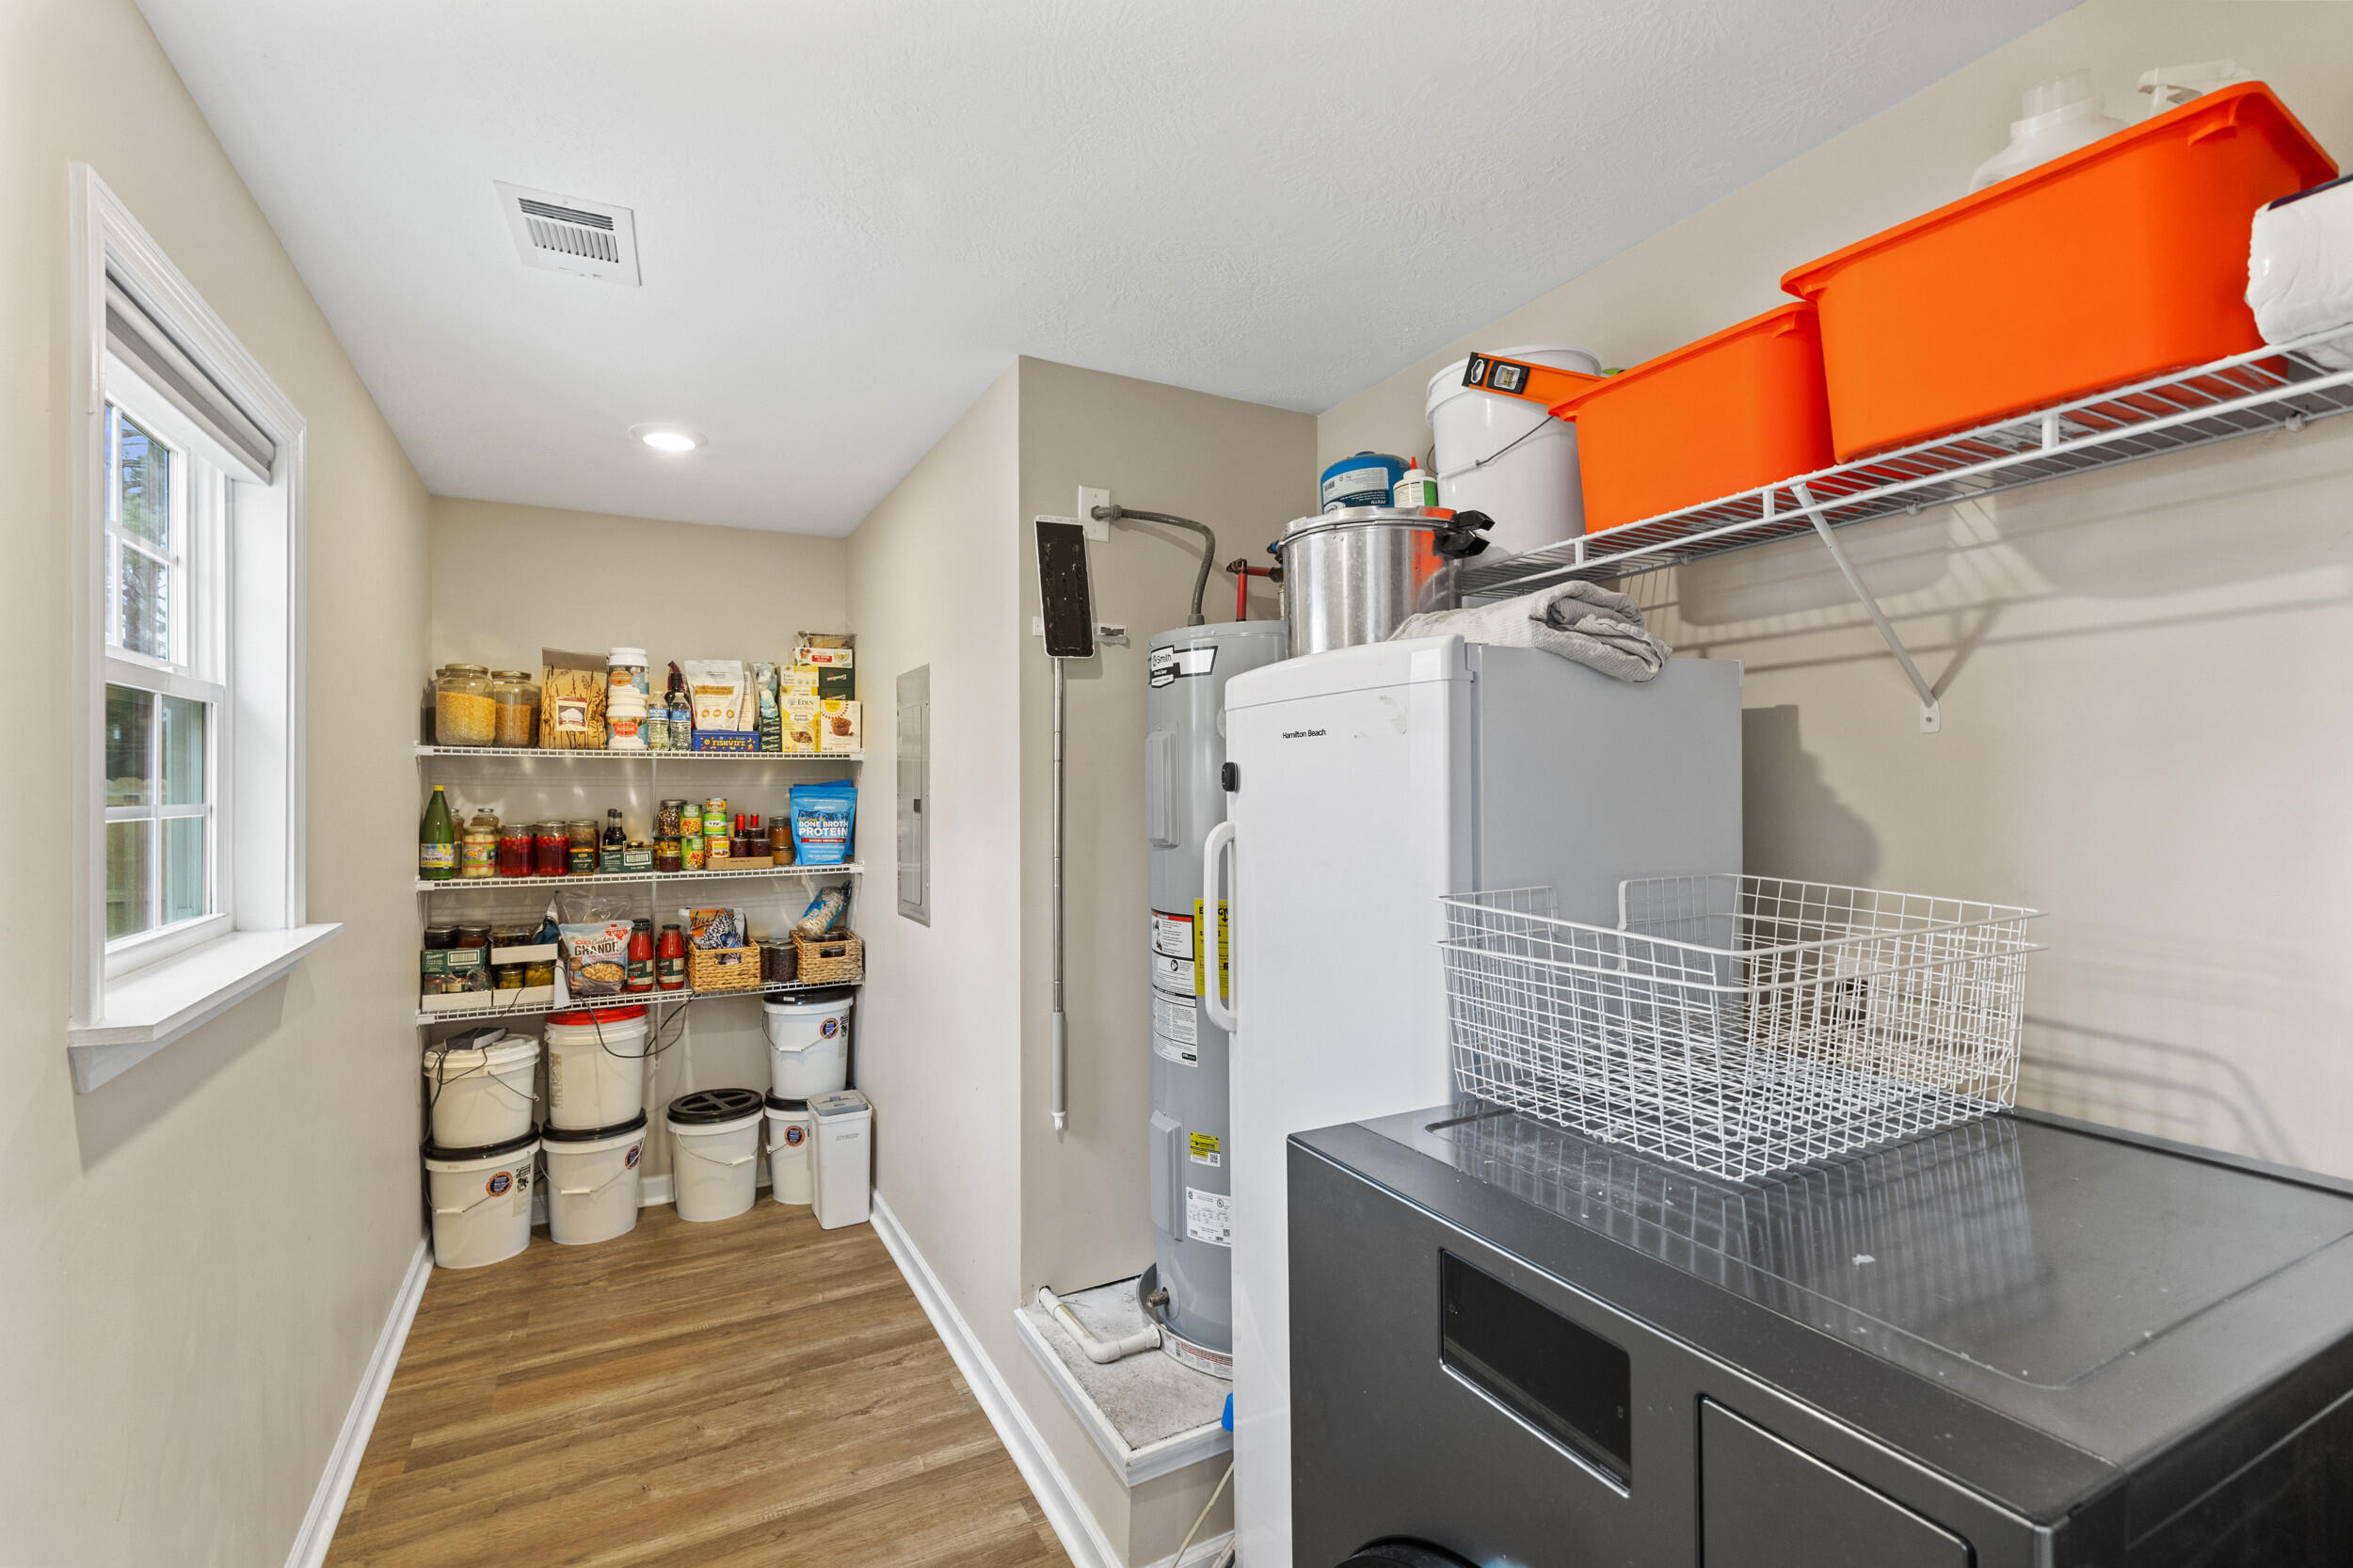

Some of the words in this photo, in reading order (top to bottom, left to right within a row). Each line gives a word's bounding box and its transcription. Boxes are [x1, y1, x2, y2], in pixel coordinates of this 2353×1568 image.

[1157, 654, 1172, 664] Smith
[1282, 730, 1306, 739] Hamilton
[1307, 728, 1326, 737] Beach
[798, 827, 848, 837] PROTEIN
